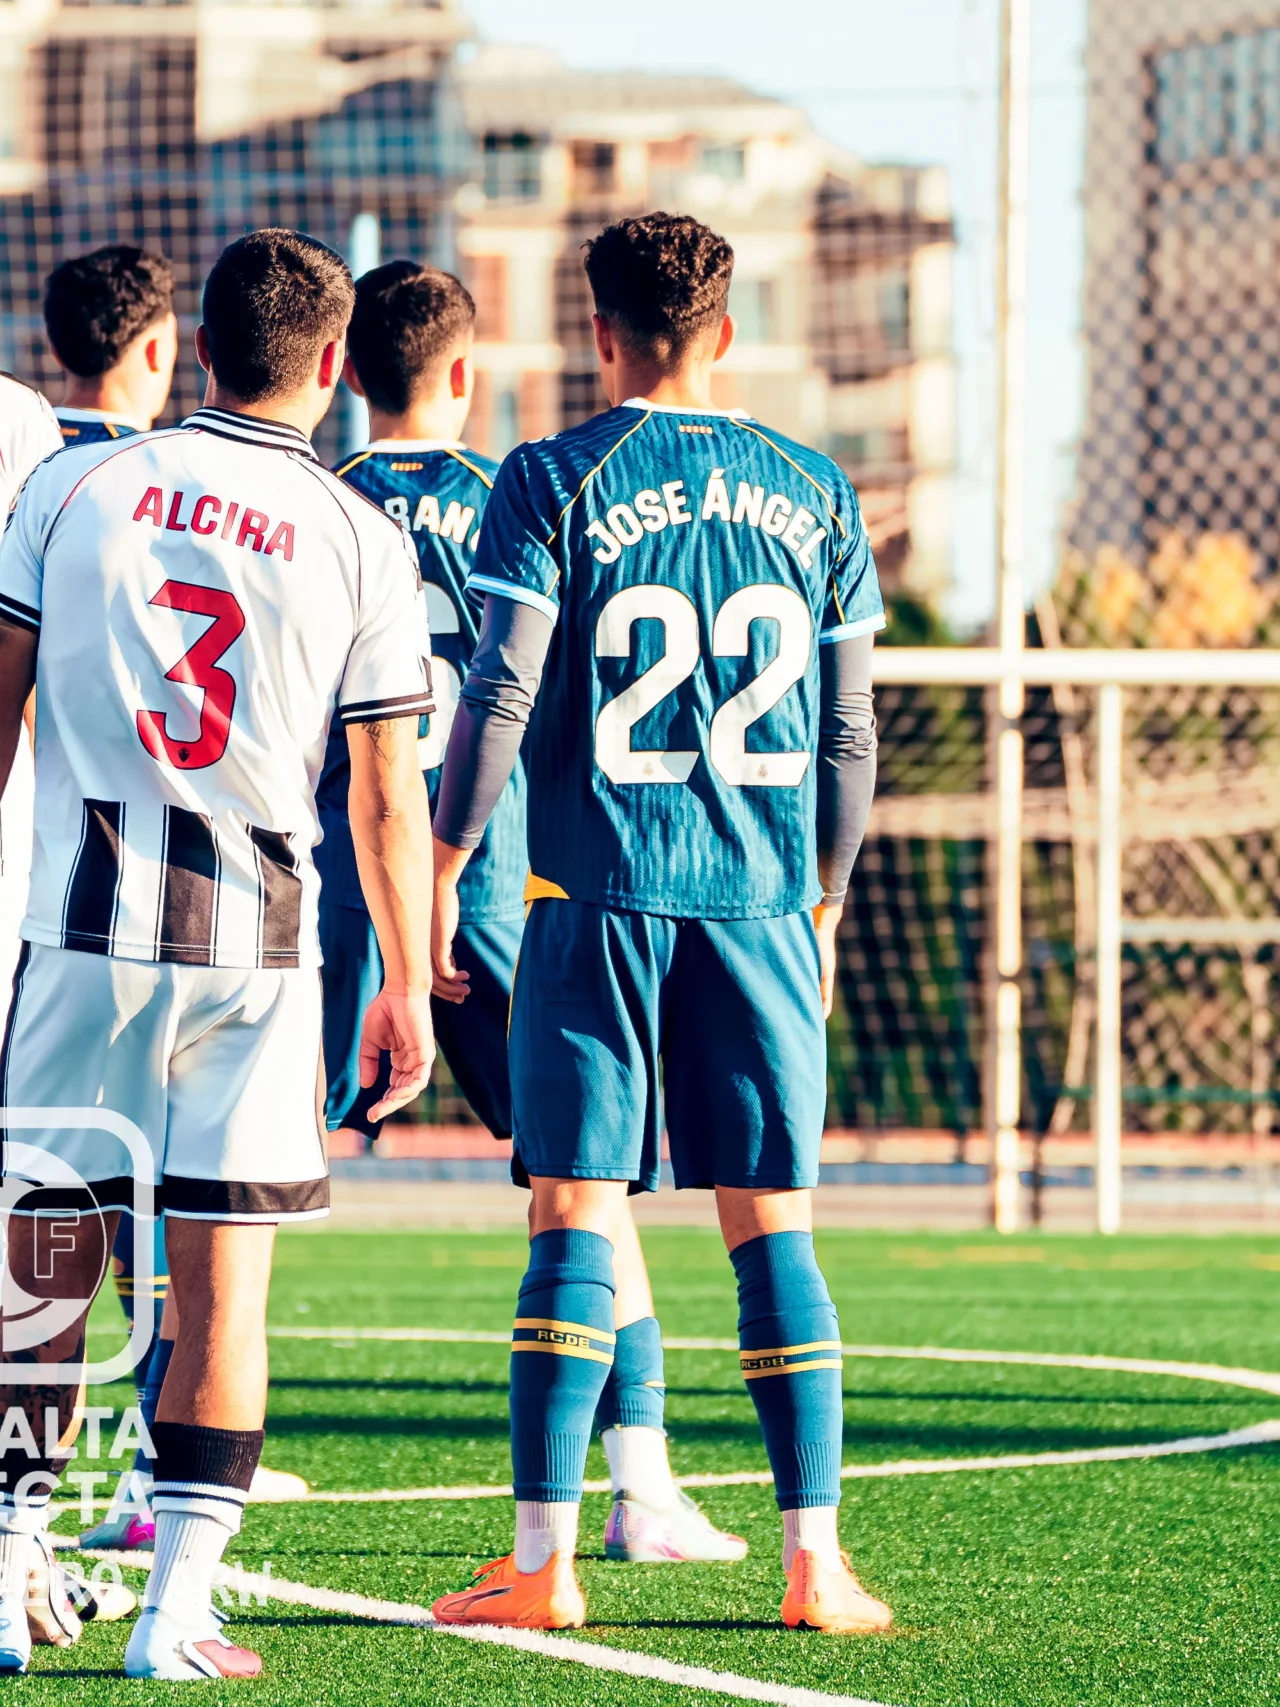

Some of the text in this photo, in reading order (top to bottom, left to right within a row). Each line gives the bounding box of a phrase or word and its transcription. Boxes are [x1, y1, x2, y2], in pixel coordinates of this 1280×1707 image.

[132, 486, 296, 562] ALCIRA
[584, 467, 827, 570] JOSE ÁNGEL
[136, 579, 246, 770] 3
[594, 583, 811, 786] 22
[537, 1330, 590, 1349] RCDE
